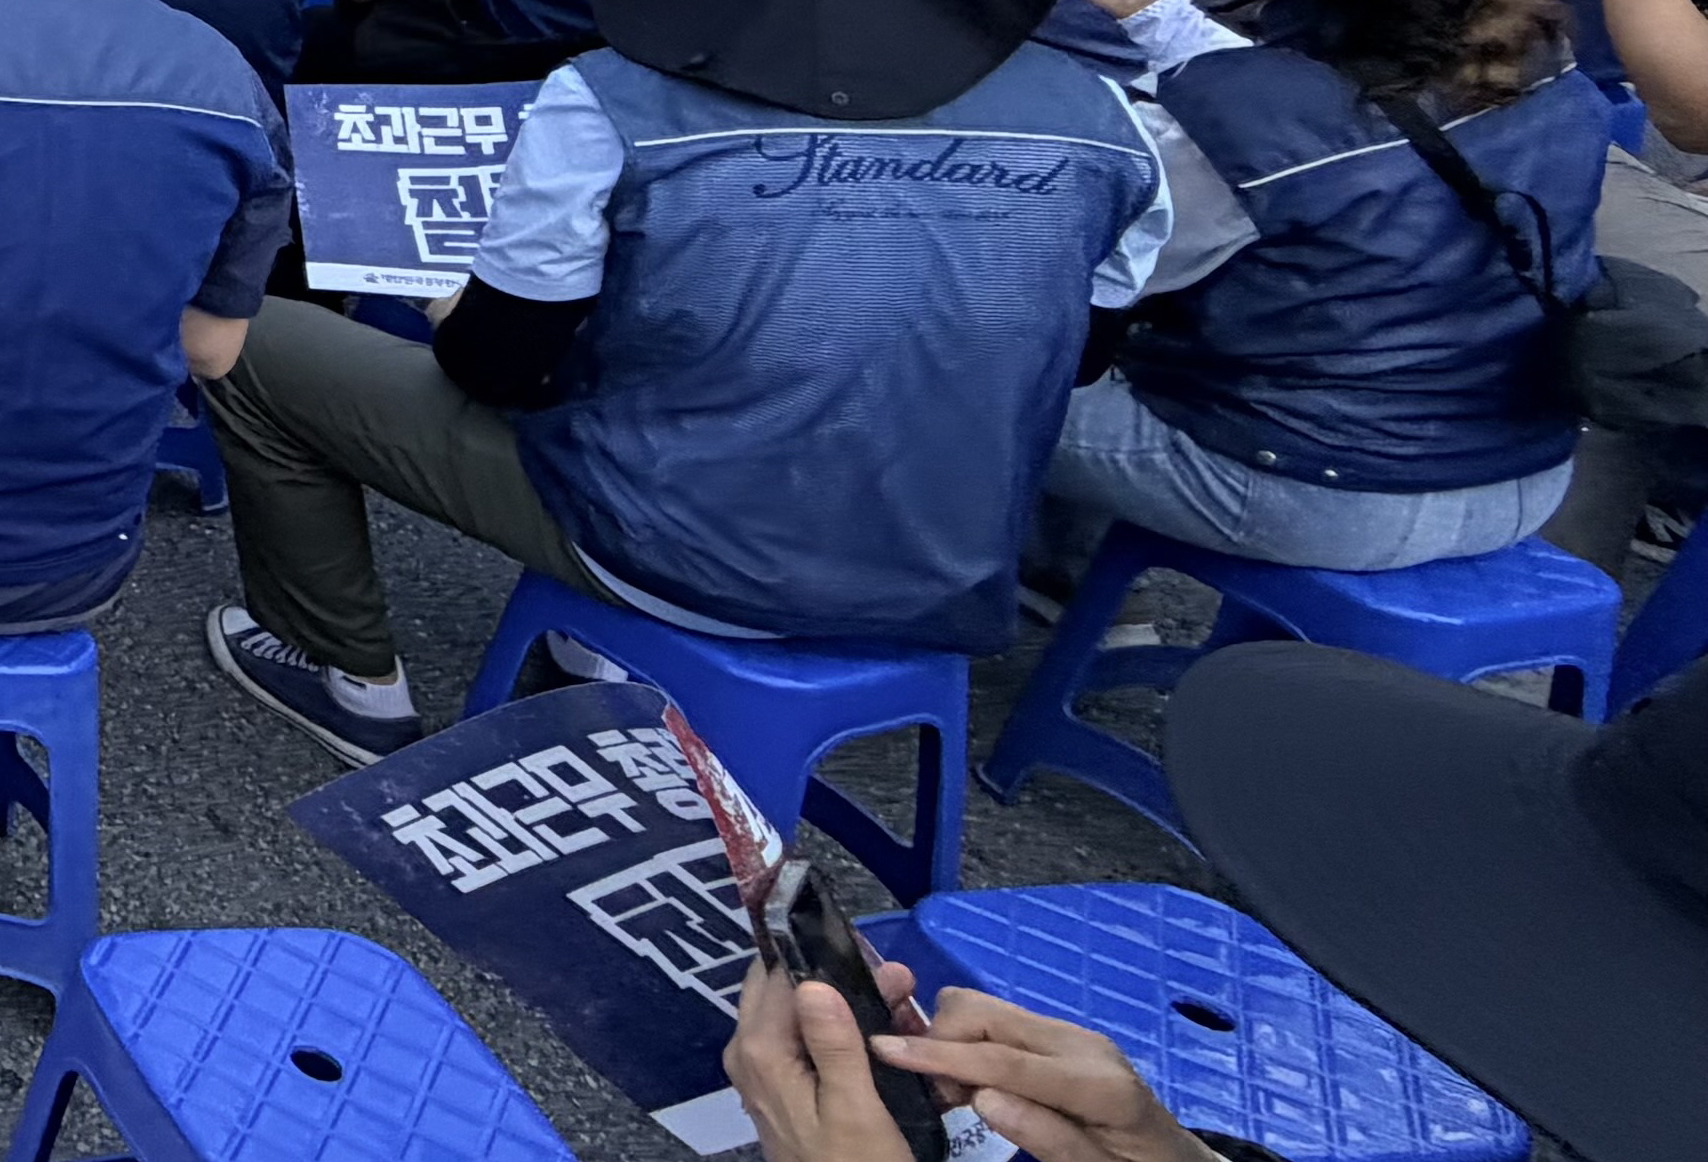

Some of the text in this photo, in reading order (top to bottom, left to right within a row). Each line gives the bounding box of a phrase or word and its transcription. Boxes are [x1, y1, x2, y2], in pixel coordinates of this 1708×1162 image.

[334, 105, 508, 157] 초과근무
[752, 134, 1071, 199] Standard
[382, 745, 647, 894] 초과근무
